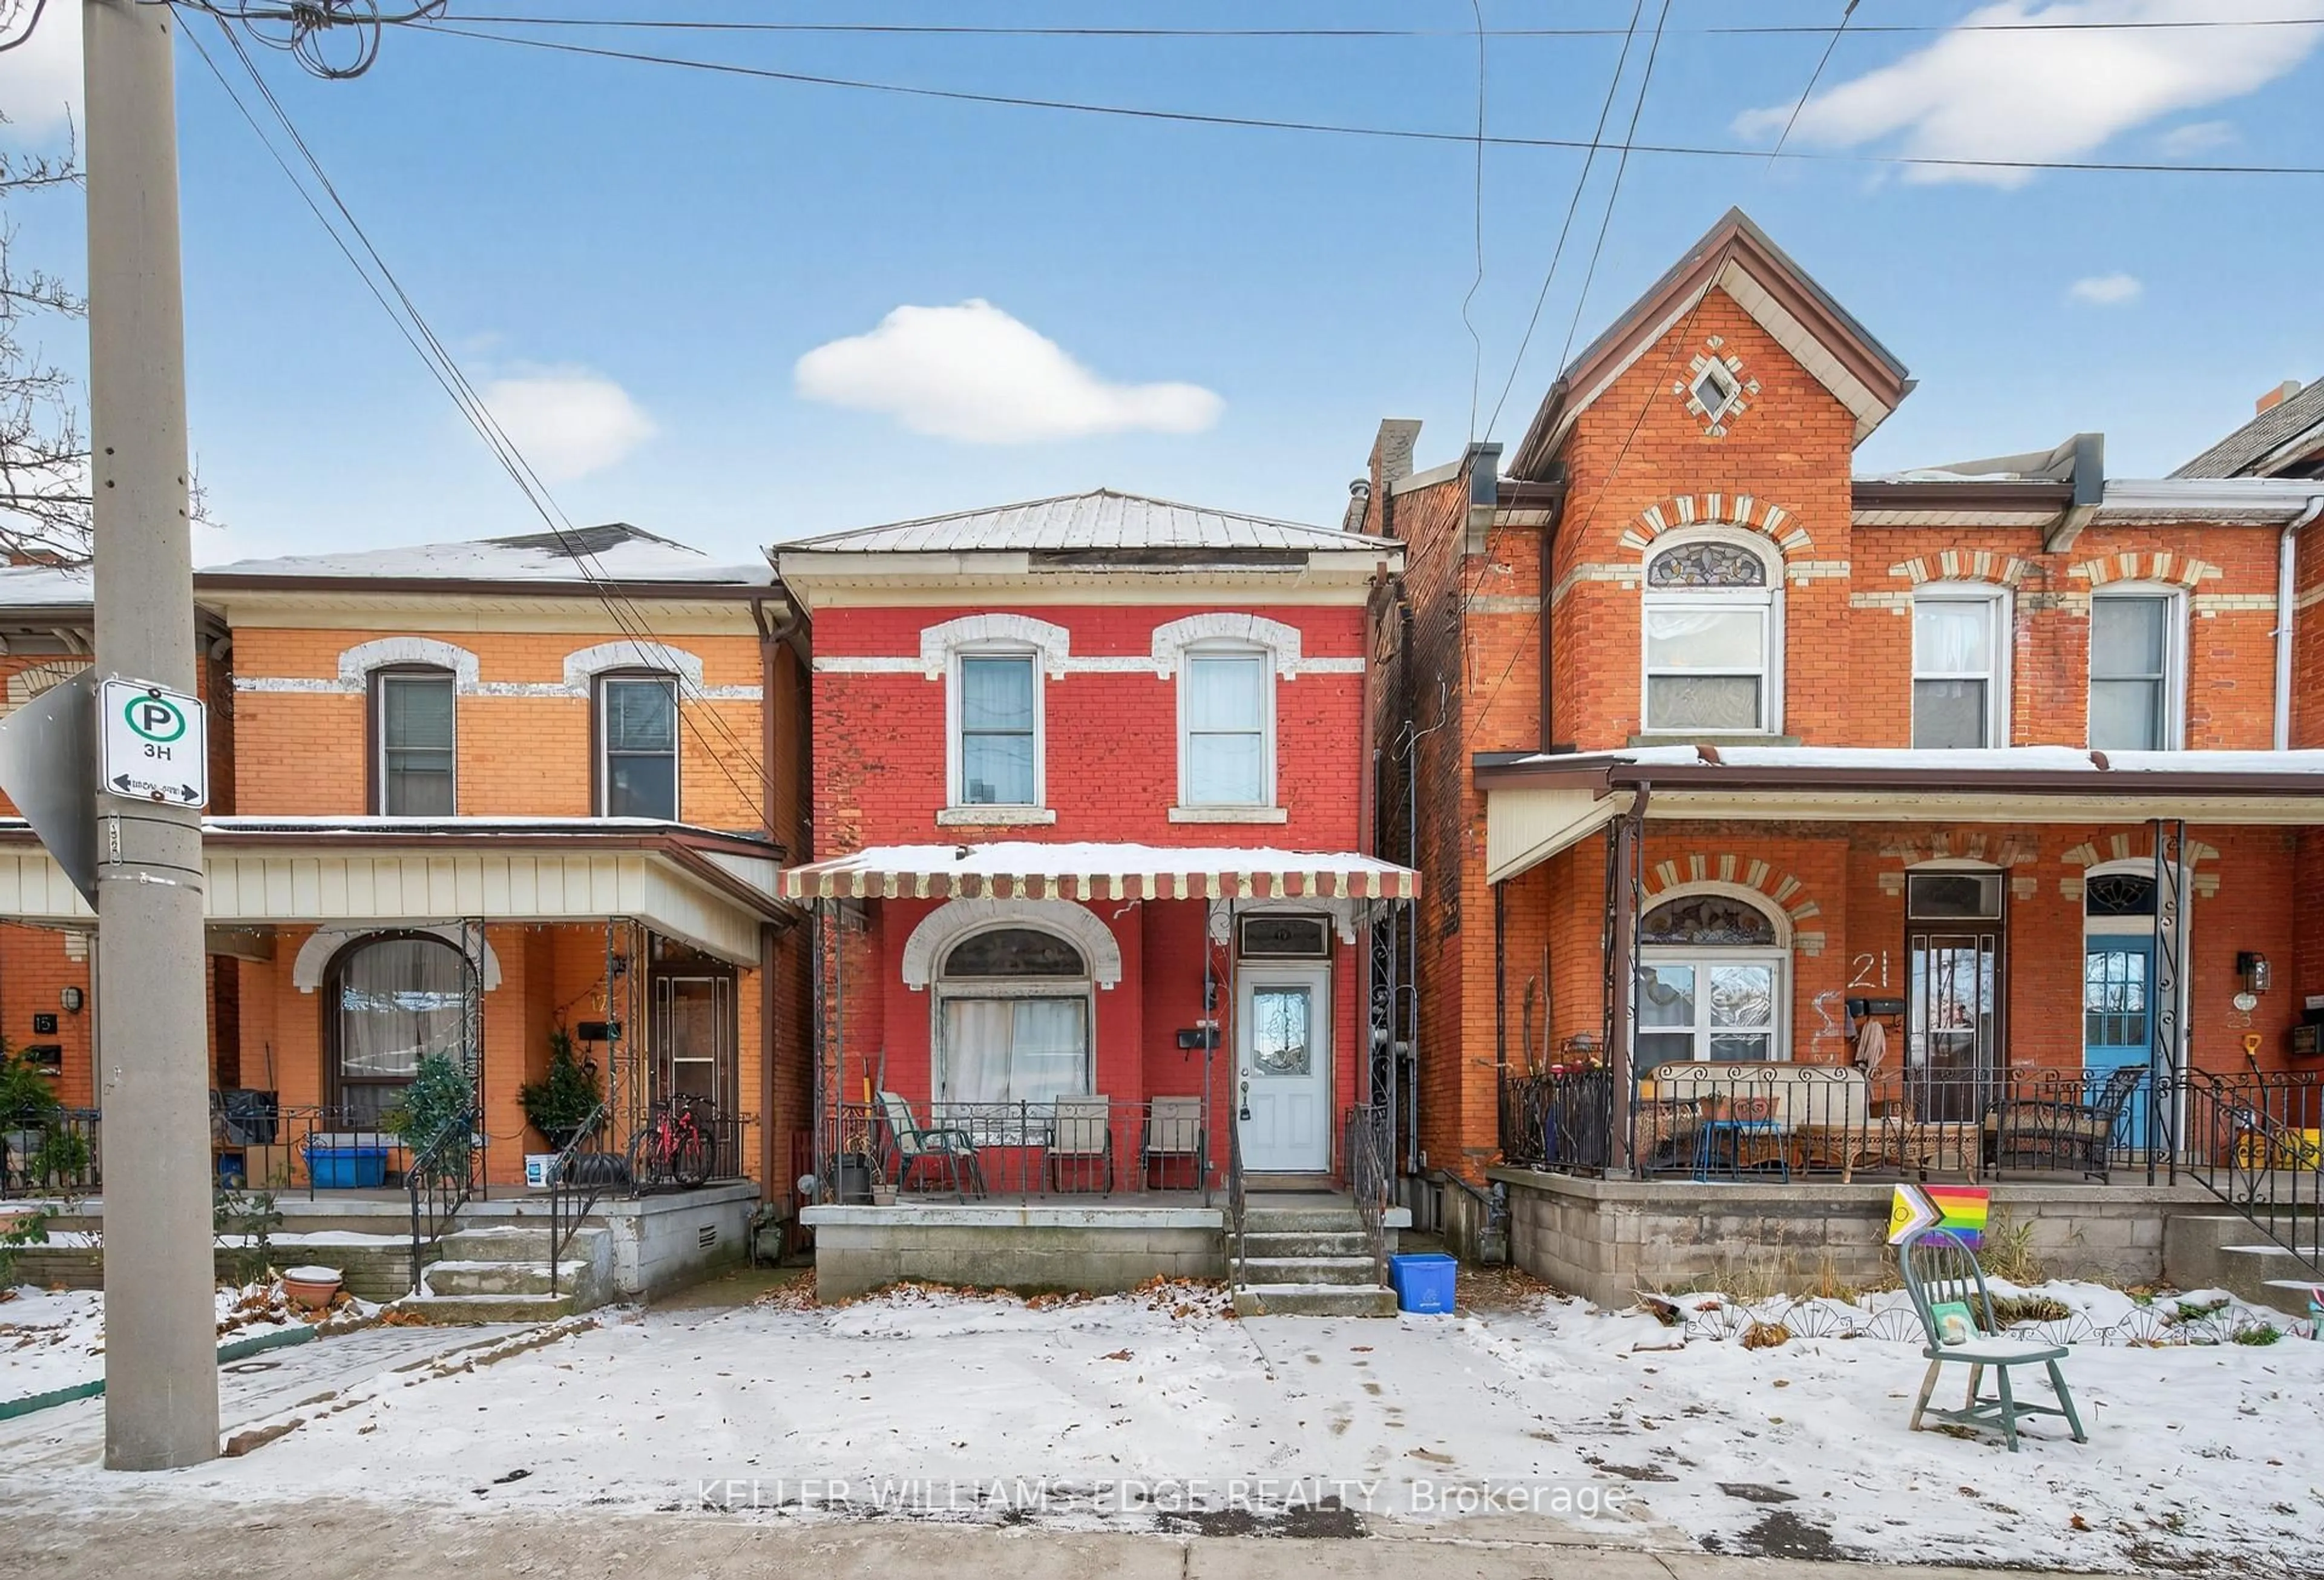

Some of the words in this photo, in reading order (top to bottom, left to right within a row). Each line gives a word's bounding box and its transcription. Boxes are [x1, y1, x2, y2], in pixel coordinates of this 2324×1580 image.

[144, 704, 171, 731] P
[144, 743, 171, 761] 3H
[1847, 950, 1887, 988] 21
[36, 1017, 50, 1031] 15
